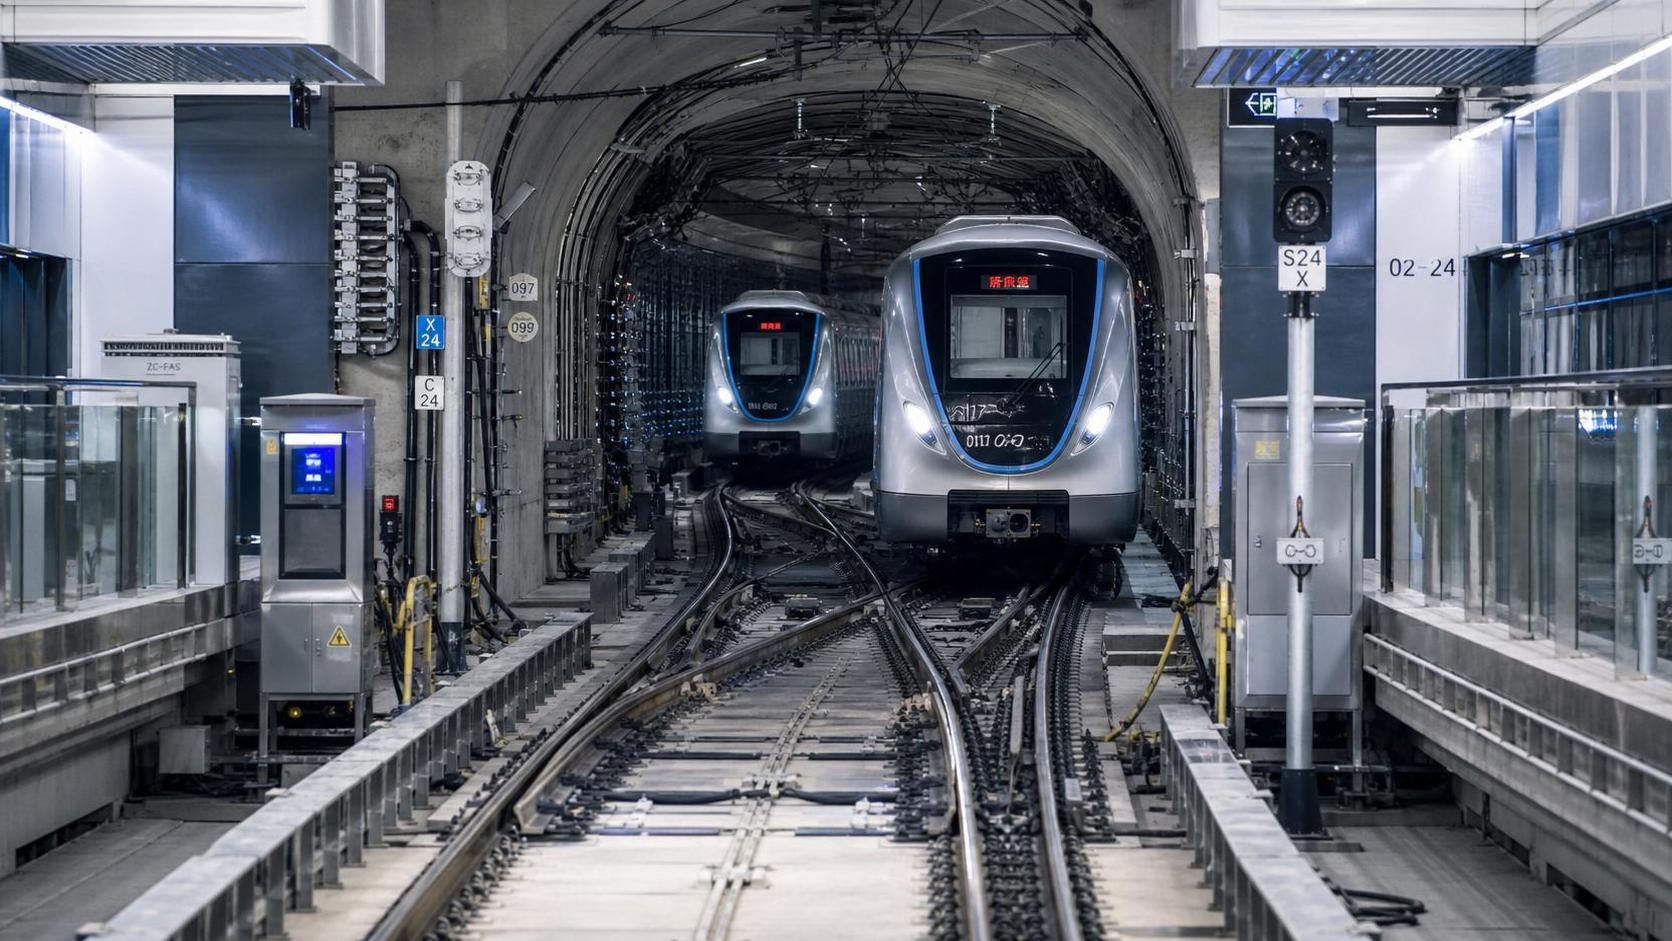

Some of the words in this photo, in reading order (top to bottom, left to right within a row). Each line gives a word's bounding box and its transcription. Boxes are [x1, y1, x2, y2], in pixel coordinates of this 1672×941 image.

[1283, 249, 1322, 267] S24
[1389, 257, 1456, 277] 02-24
[1296, 270, 1309, 288] X
[511, 282, 535, 295] 097
[425, 317, 436, 332] X
[511, 321, 535, 334] 099
[421, 333, 441, 347] 24
[424, 377, 435, 392] C
[420, 393, 439, 408] 24
